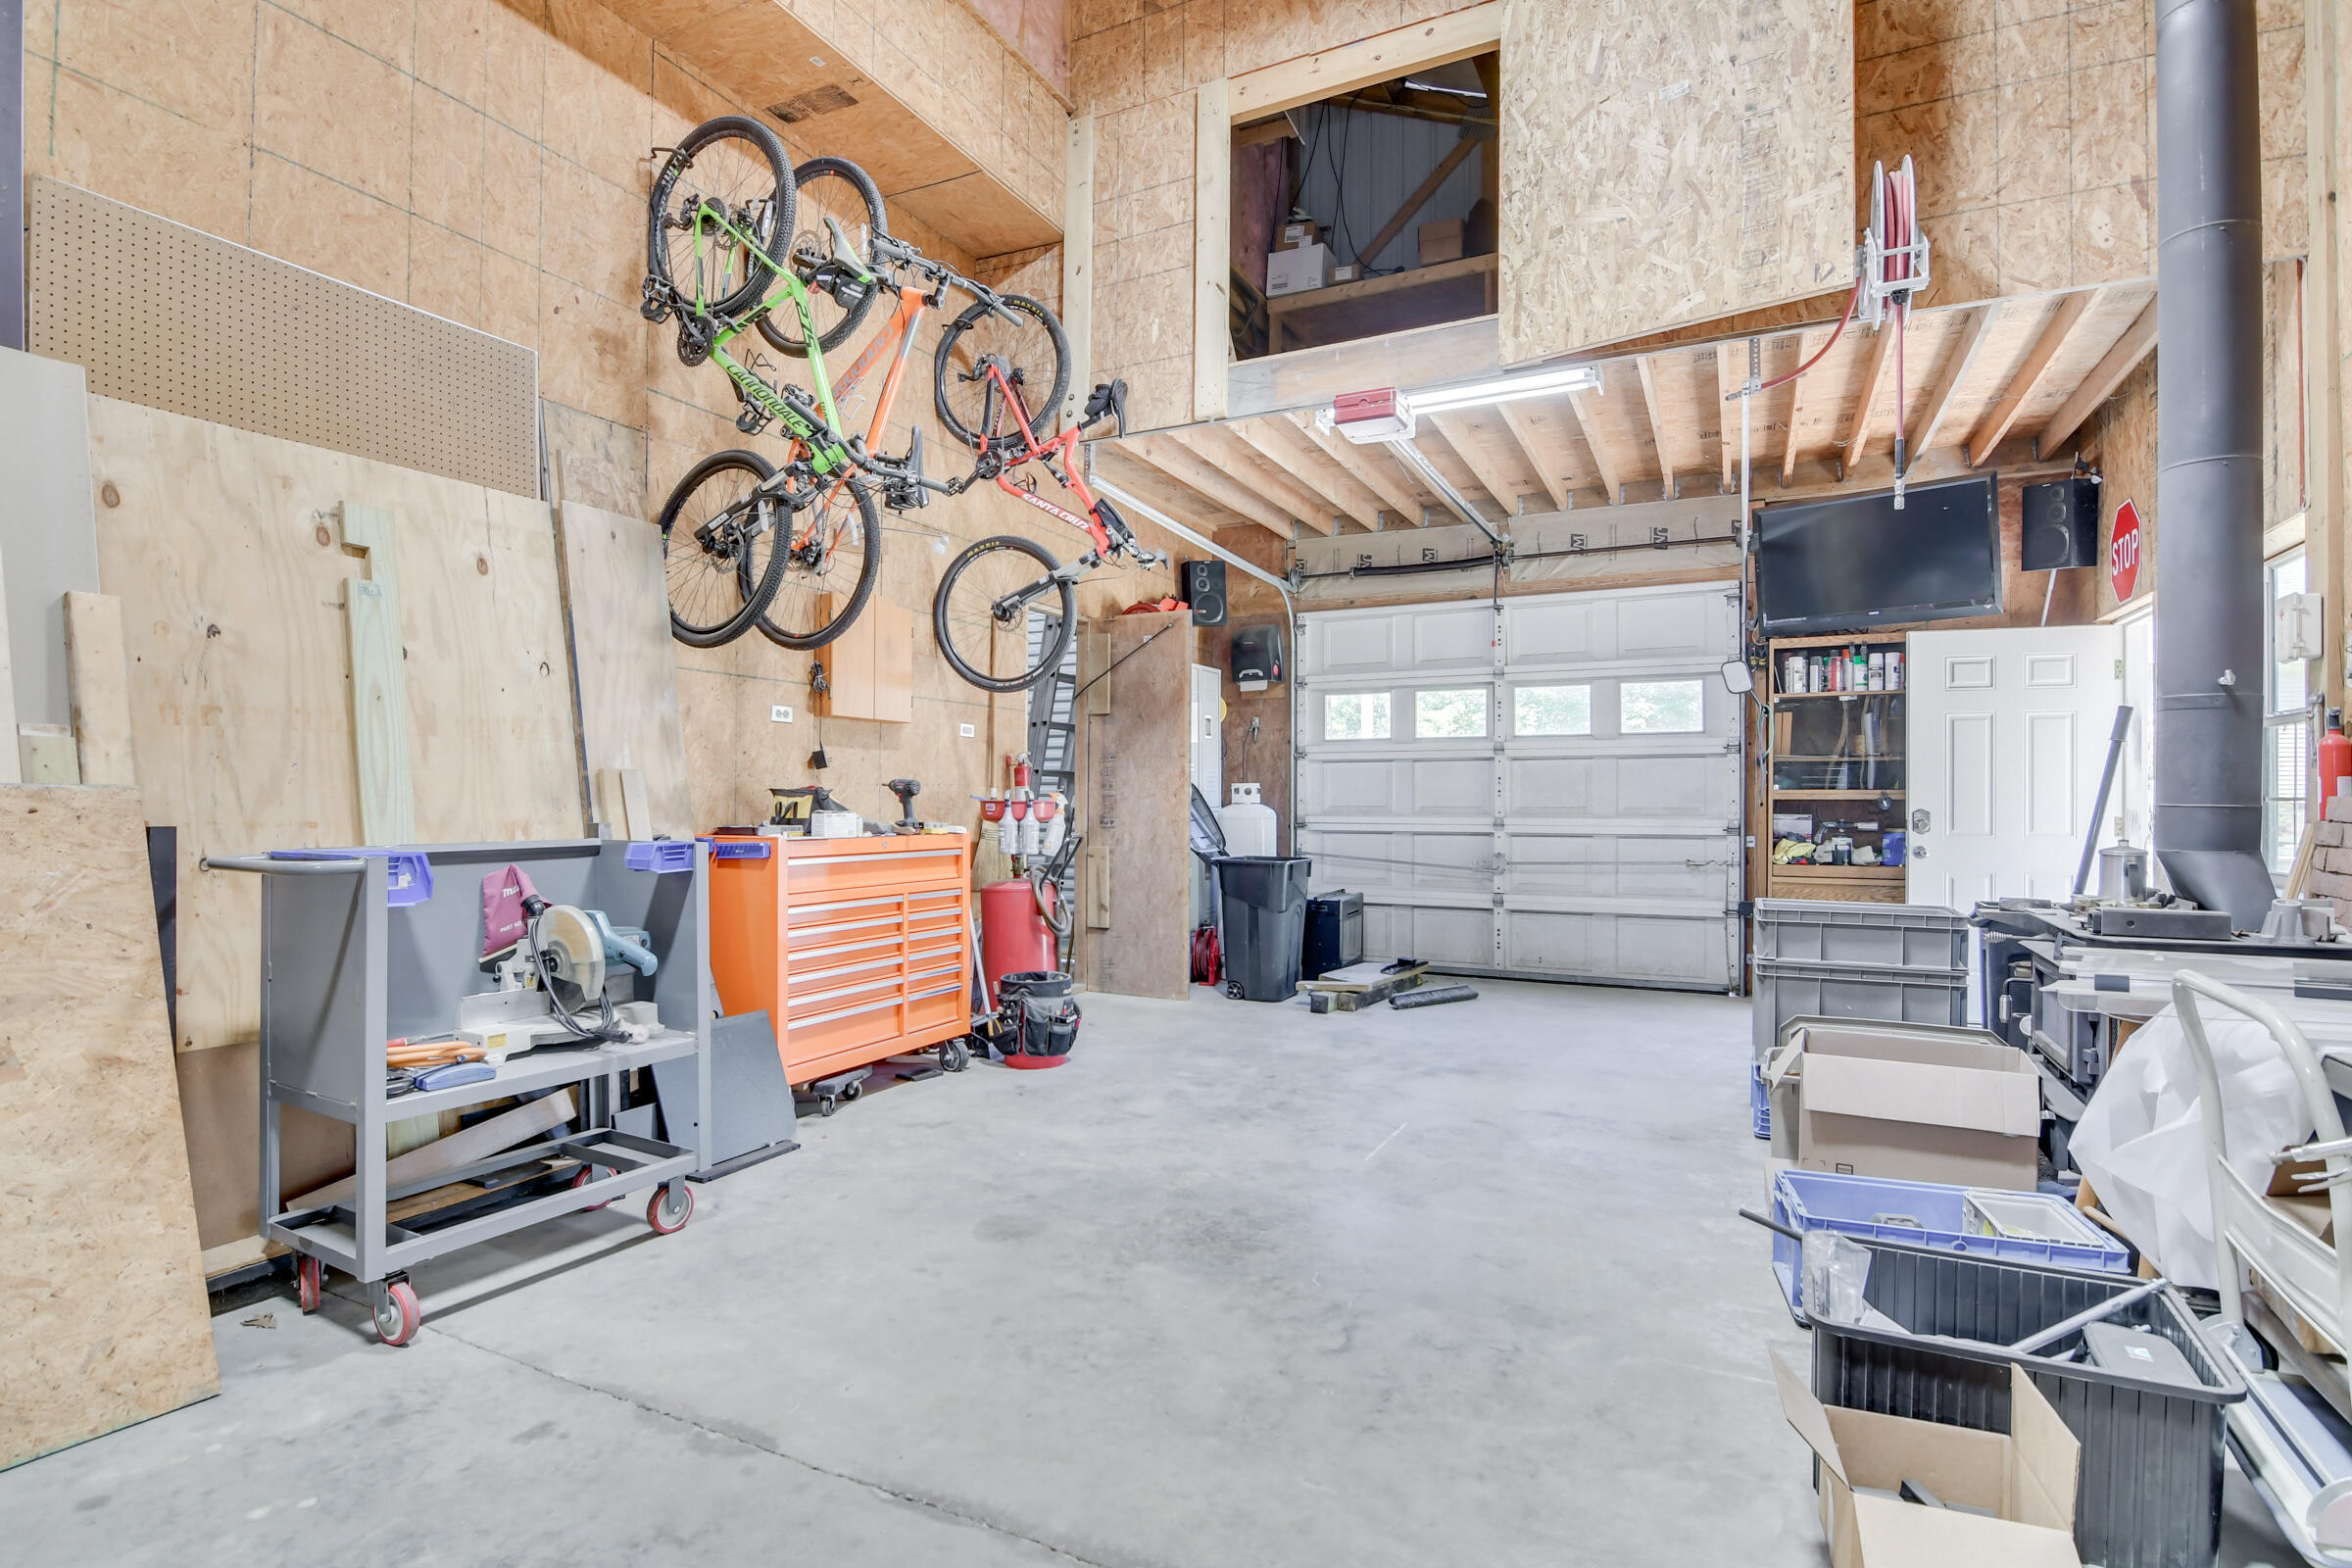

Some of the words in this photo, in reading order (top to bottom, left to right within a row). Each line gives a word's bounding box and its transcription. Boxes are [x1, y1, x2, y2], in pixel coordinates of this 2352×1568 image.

[1022, 493, 1059, 515] SANTA
[1058, 511, 1091, 530] CRUZ
[2112, 528, 2138, 576] STOP
[500, 924, 514, 933] PART
